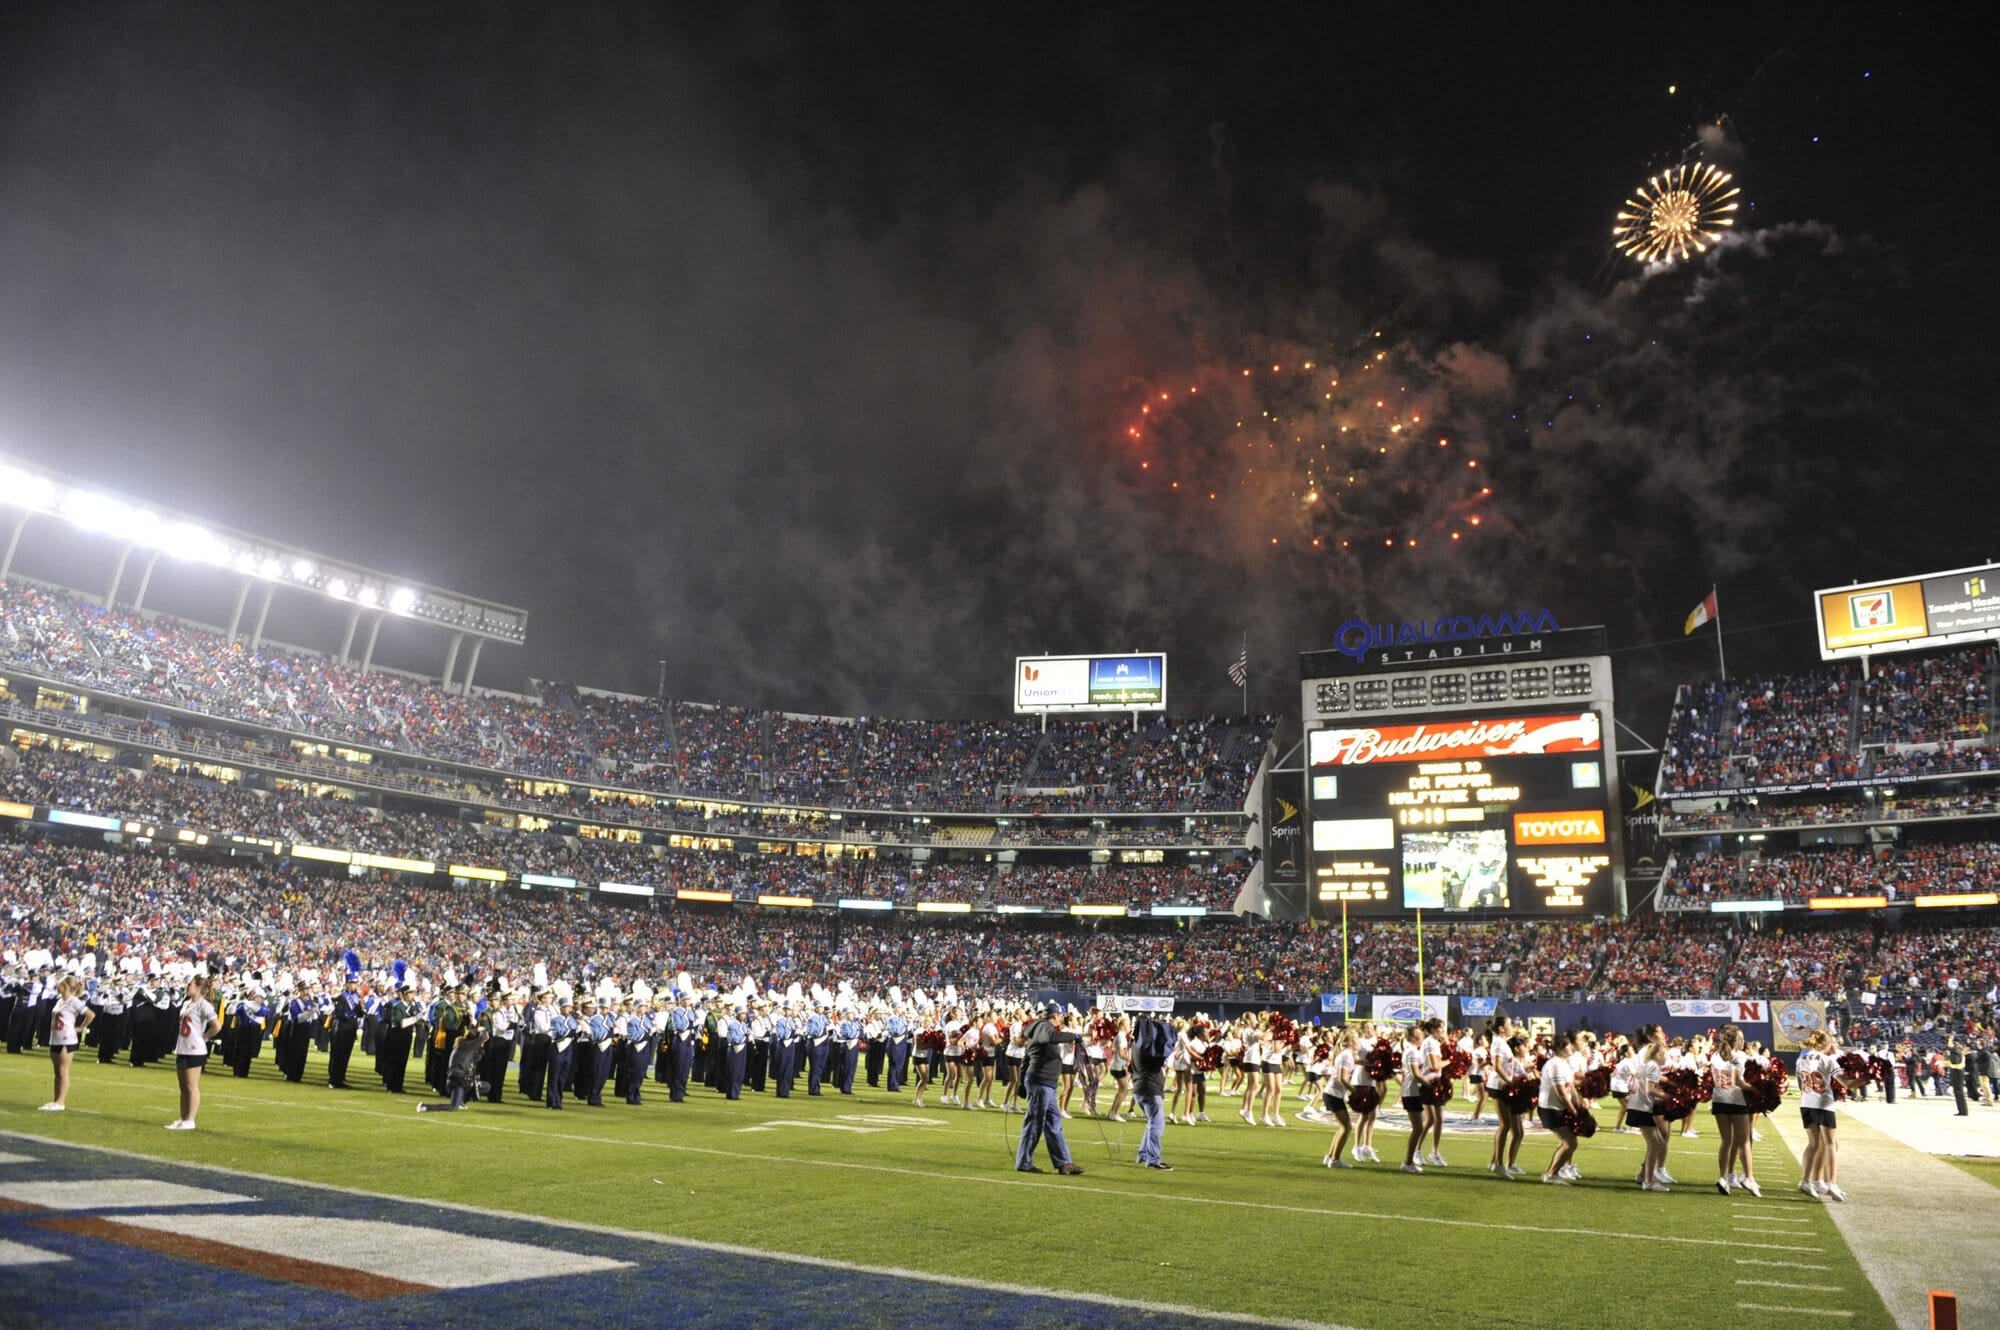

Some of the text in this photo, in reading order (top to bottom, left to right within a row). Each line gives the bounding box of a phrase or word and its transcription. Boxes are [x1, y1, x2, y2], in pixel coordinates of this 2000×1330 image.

[1335, 608, 1561, 663] QUALCOMM
[1381, 640, 1542, 663] STADIUM
[1337, 720, 1526, 765] Budweiser
[1518, 818, 1601, 838] TOYOTA
[1624, 814, 1660, 826] Sprint
[1272, 826, 1301, 838] Sprint
[1738, 1002, 1760, 1020] N
